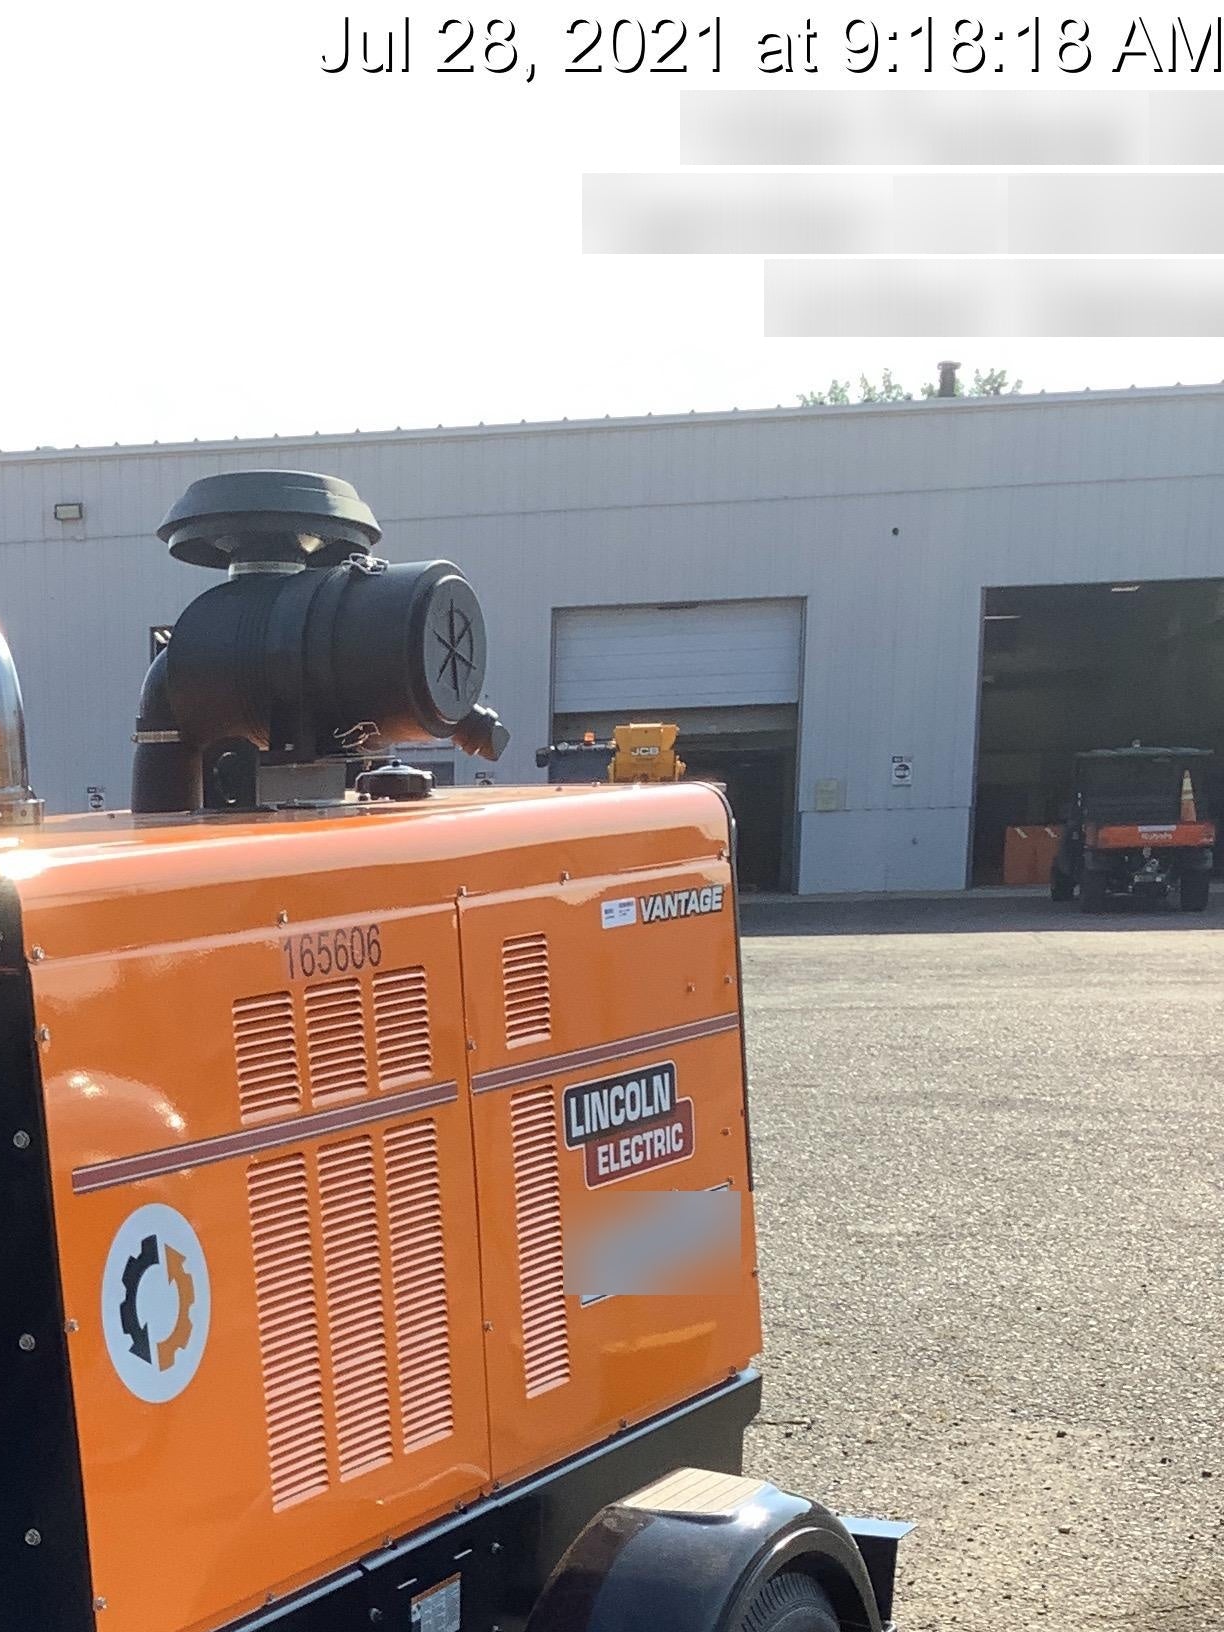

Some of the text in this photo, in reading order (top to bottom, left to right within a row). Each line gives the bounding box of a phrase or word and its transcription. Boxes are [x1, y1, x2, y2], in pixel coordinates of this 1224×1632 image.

[631, 746, 660, 756] JCB
[639, 884, 725, 924] VANTAGE
[282, 923, 383, 979] 165606
[569, 1071, 671, 1138] LINCOLN
[596, 1122, 685, 1177] ELECTRIC
